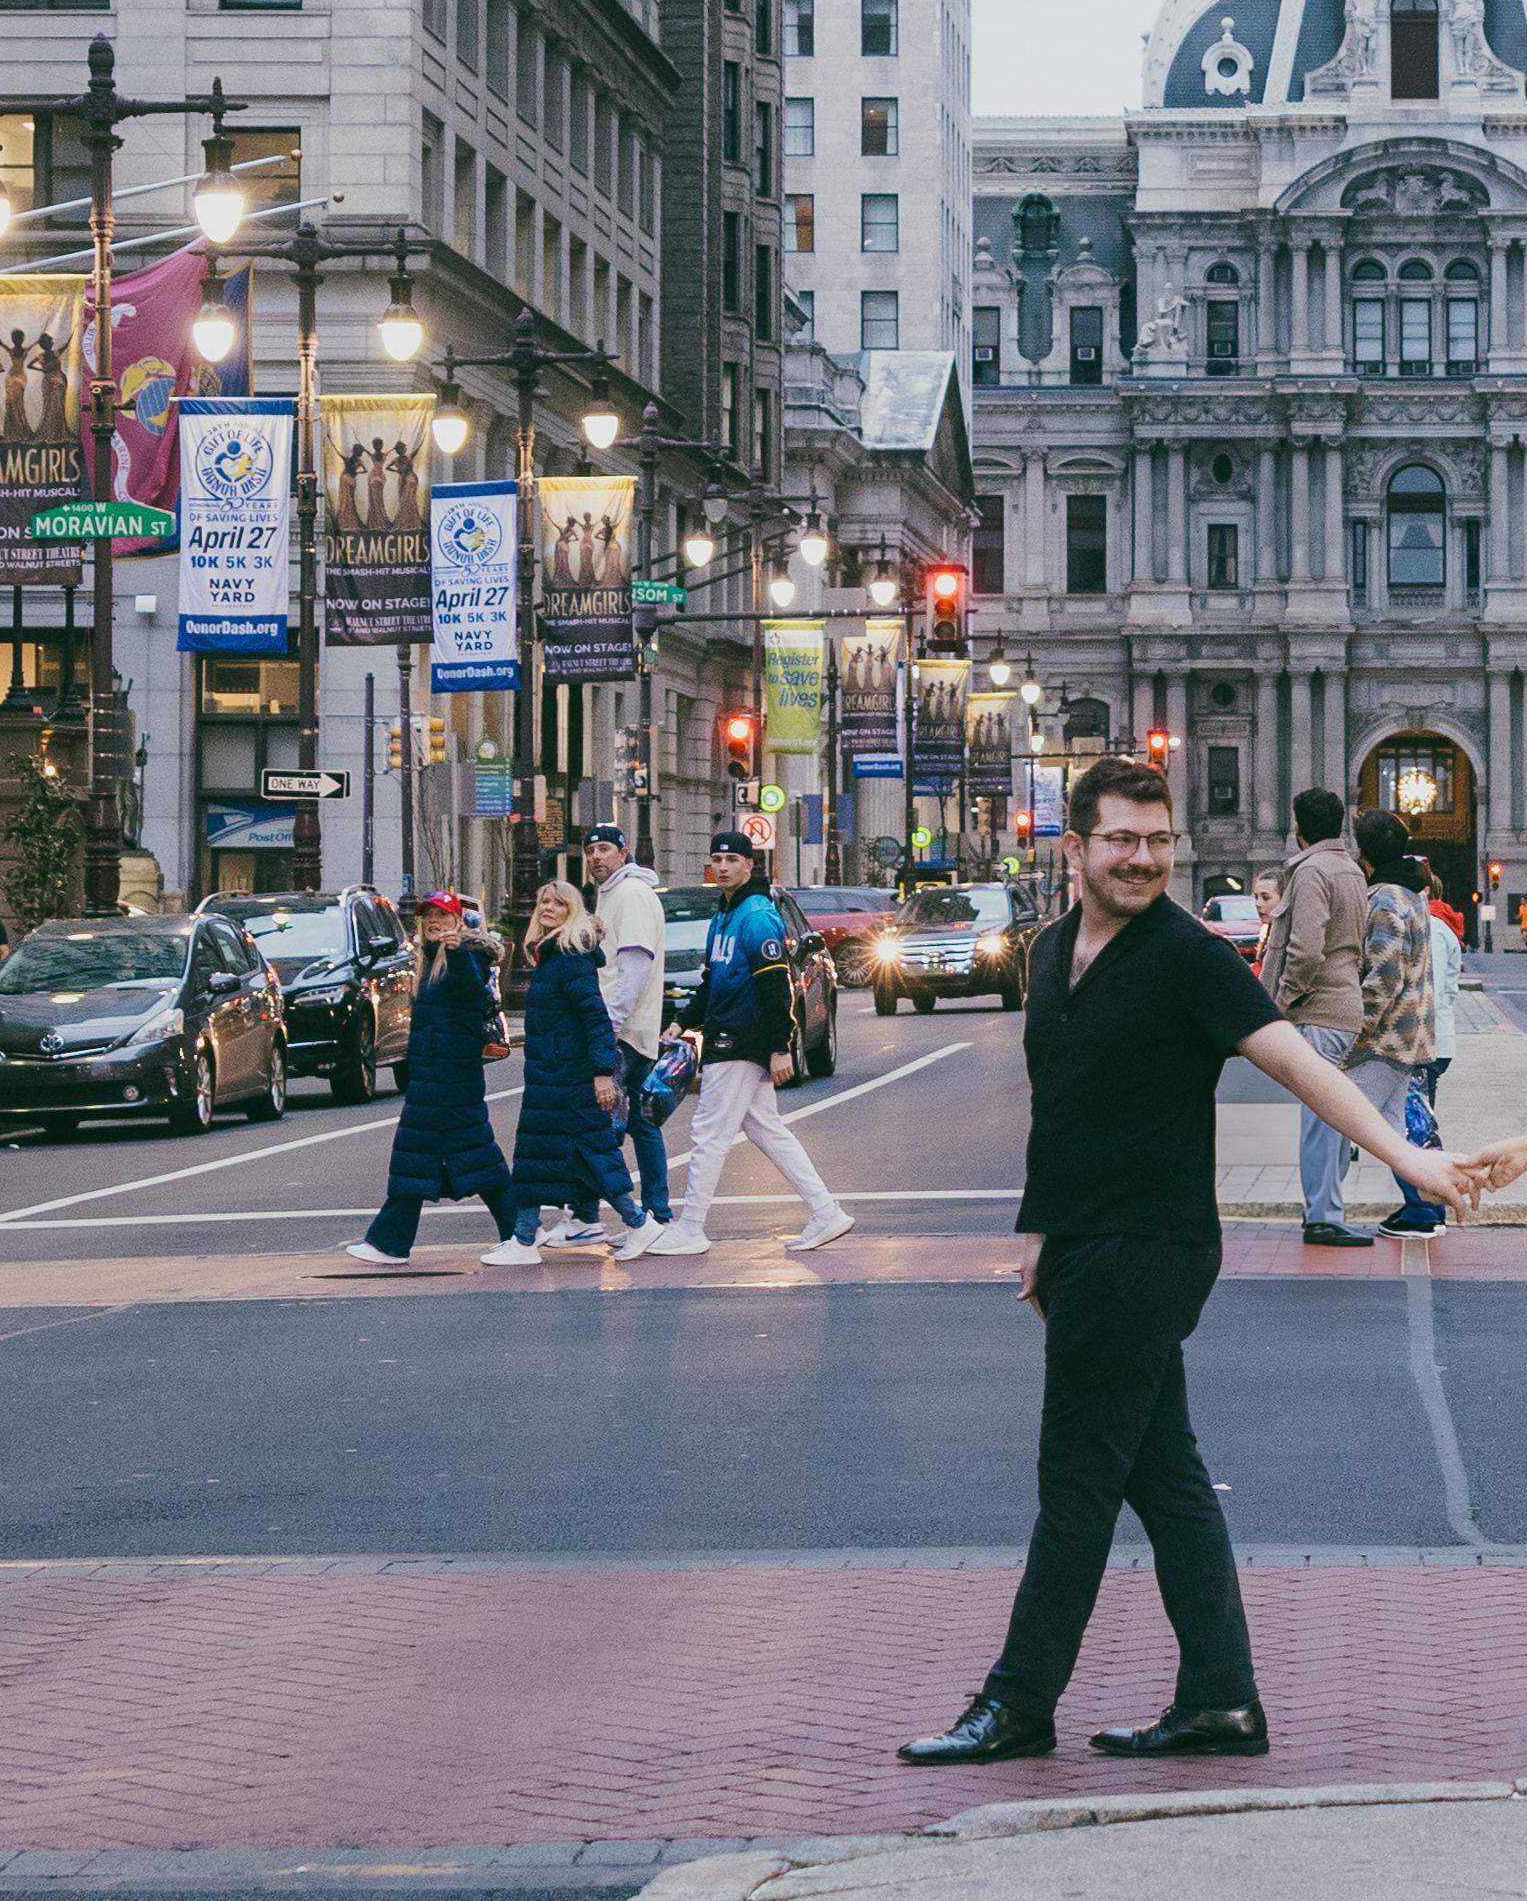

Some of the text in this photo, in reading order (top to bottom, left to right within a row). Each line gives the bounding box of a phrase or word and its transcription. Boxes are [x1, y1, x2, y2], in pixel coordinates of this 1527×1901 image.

[72, 504, 94, 512] 1400
[35, 516, 167, 536] MORAVIAN ST
[189, 526, 277, 553] April 27
[325, 535, 430, 564] DREAMGIRLS
[191, 556, 272, 568] 10K 5K 3K
[210, 579, 255, 589] NAVY
[210, 592, 255, 602] YARD
[436, 587, 509, 612] April 27
[326, 599, 382, 610] NOW ON
[544, 591, 631, 616] DREAMGIRLS
[438, 614, 461, 624] 10K
[455, 631, 492, 640] NAVY
[456, 642, 493, 651] YARD
[782, 671, 819, 686] save
[779, 690, 817, 708] lives
[271, 778, 320, 790] ONE WAY
[249, 833, 292, 842] Post Off
